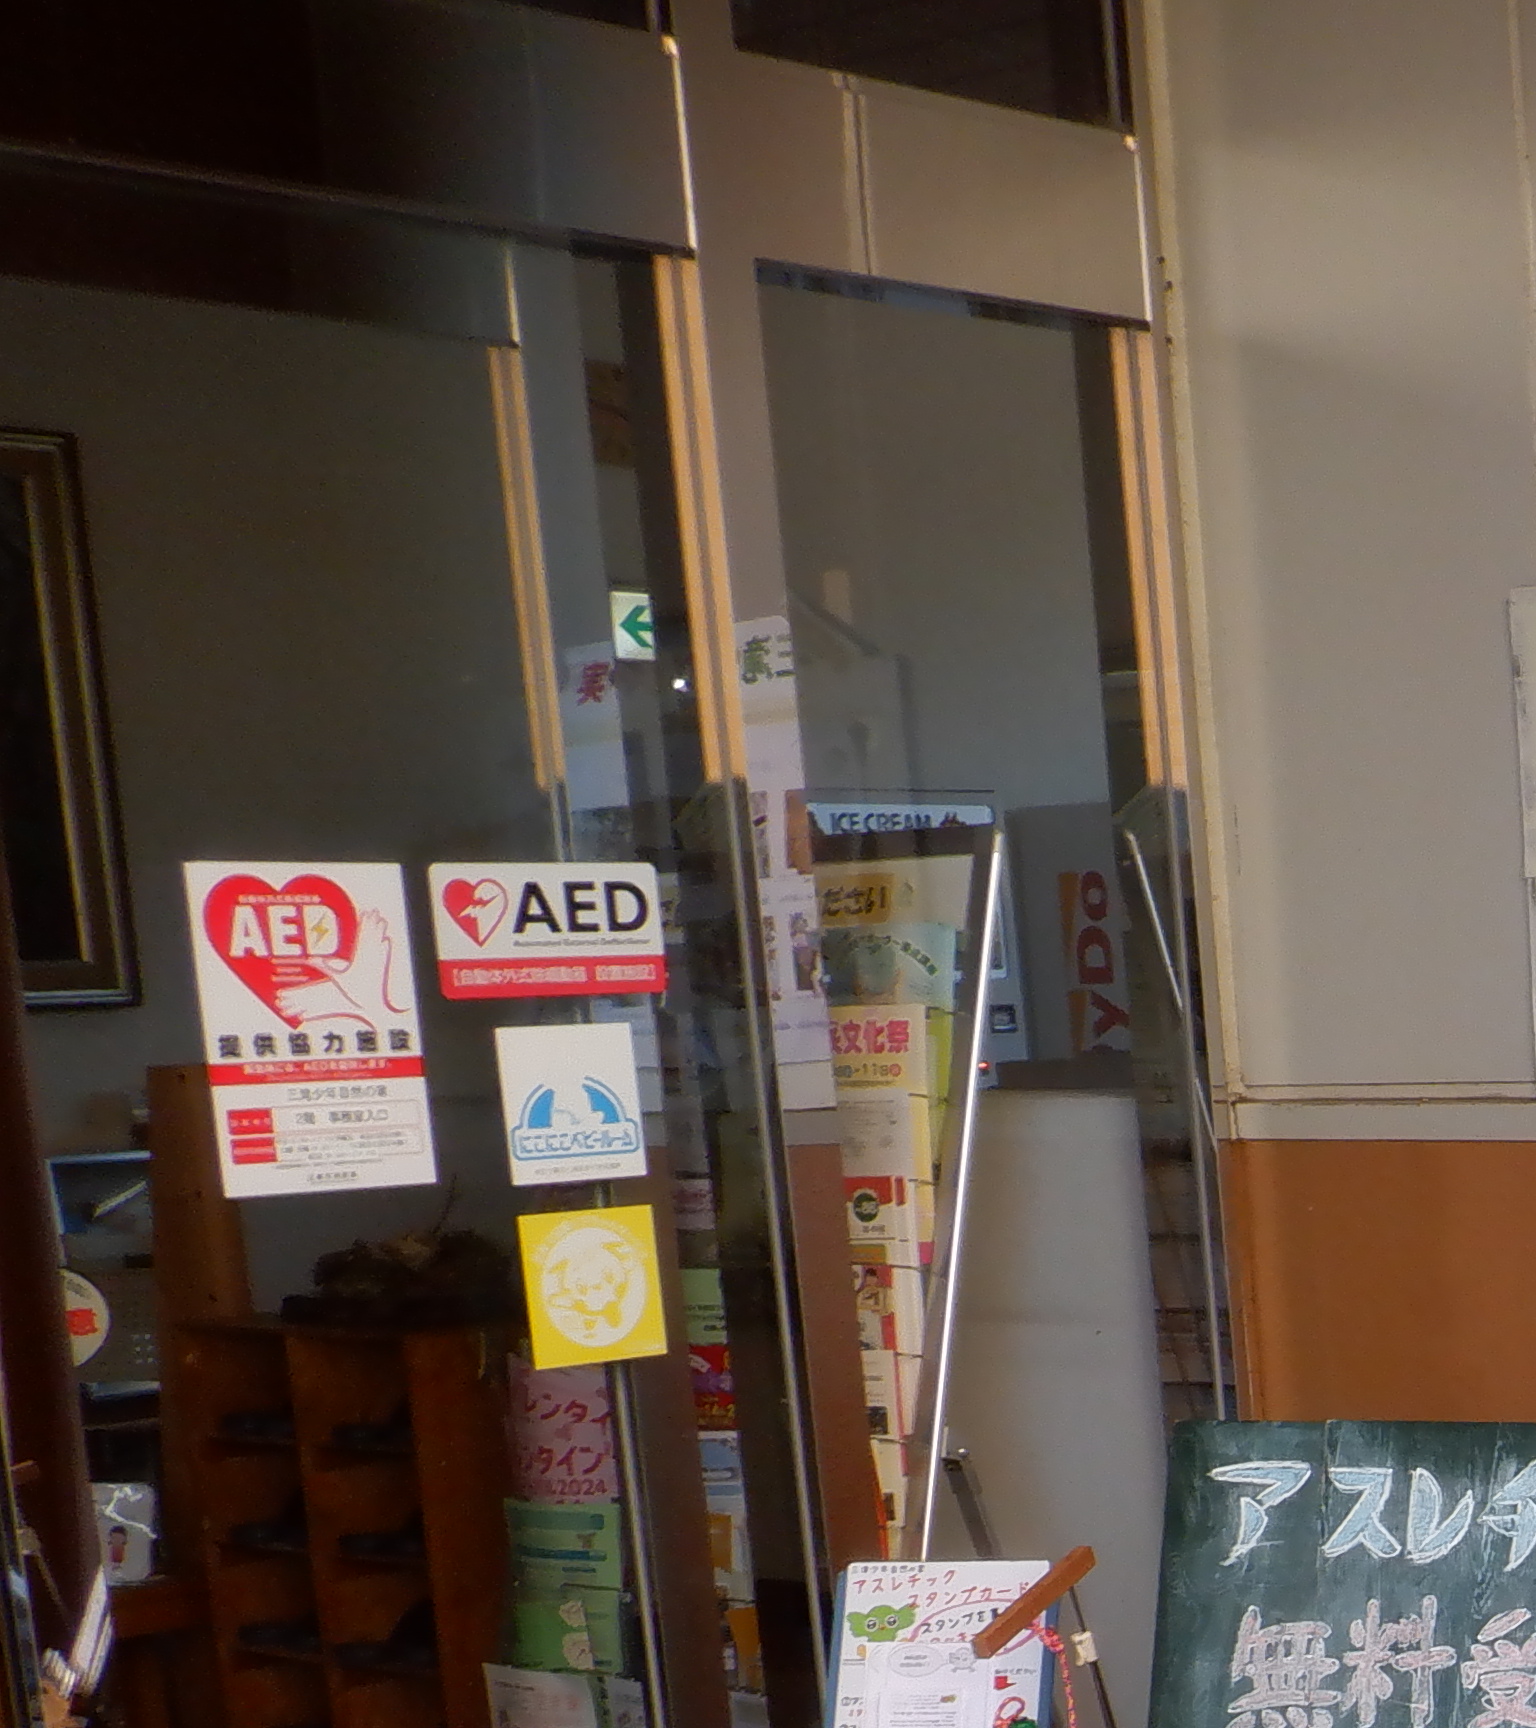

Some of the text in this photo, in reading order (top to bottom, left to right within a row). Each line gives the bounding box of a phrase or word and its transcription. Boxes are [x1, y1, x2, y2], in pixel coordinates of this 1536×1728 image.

[830, 812, 860, 833] ICE
[513, 880, 649, 934] AED
[229, 904, 340, 957] AED
[218, 1029, 411, 1058] 提供協力施設
[853, 1569, 957, 1594] アスレチック
[908, 1581, 1031, 1608] スタンプカード
